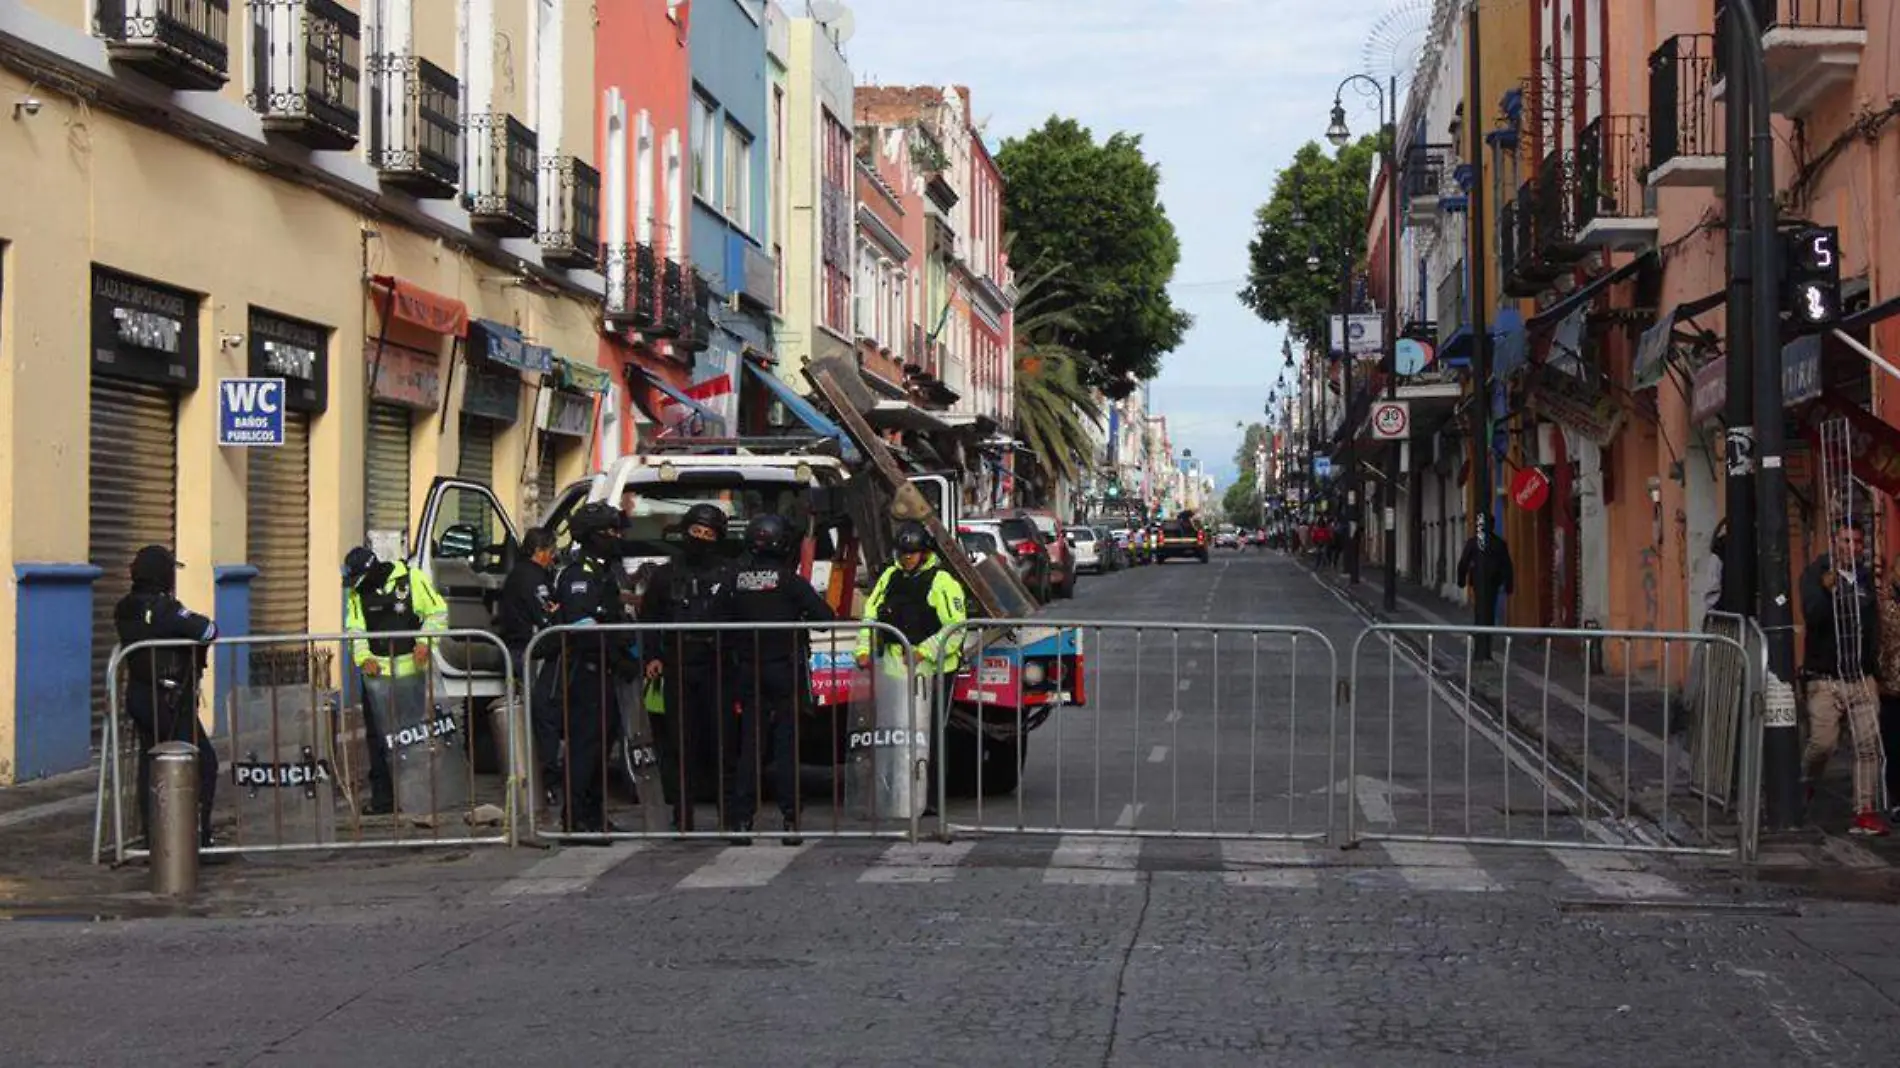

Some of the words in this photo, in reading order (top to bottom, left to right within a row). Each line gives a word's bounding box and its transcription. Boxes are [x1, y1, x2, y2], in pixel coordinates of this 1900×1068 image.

[1815, 237, 1831, 266] 5
[226, 383, 277, 413] WC
[235, 416, 268, 428] BAÑOS
[849, 729, 927, 749] POLICIA
[238, 764, 329, 783] POLICIA
